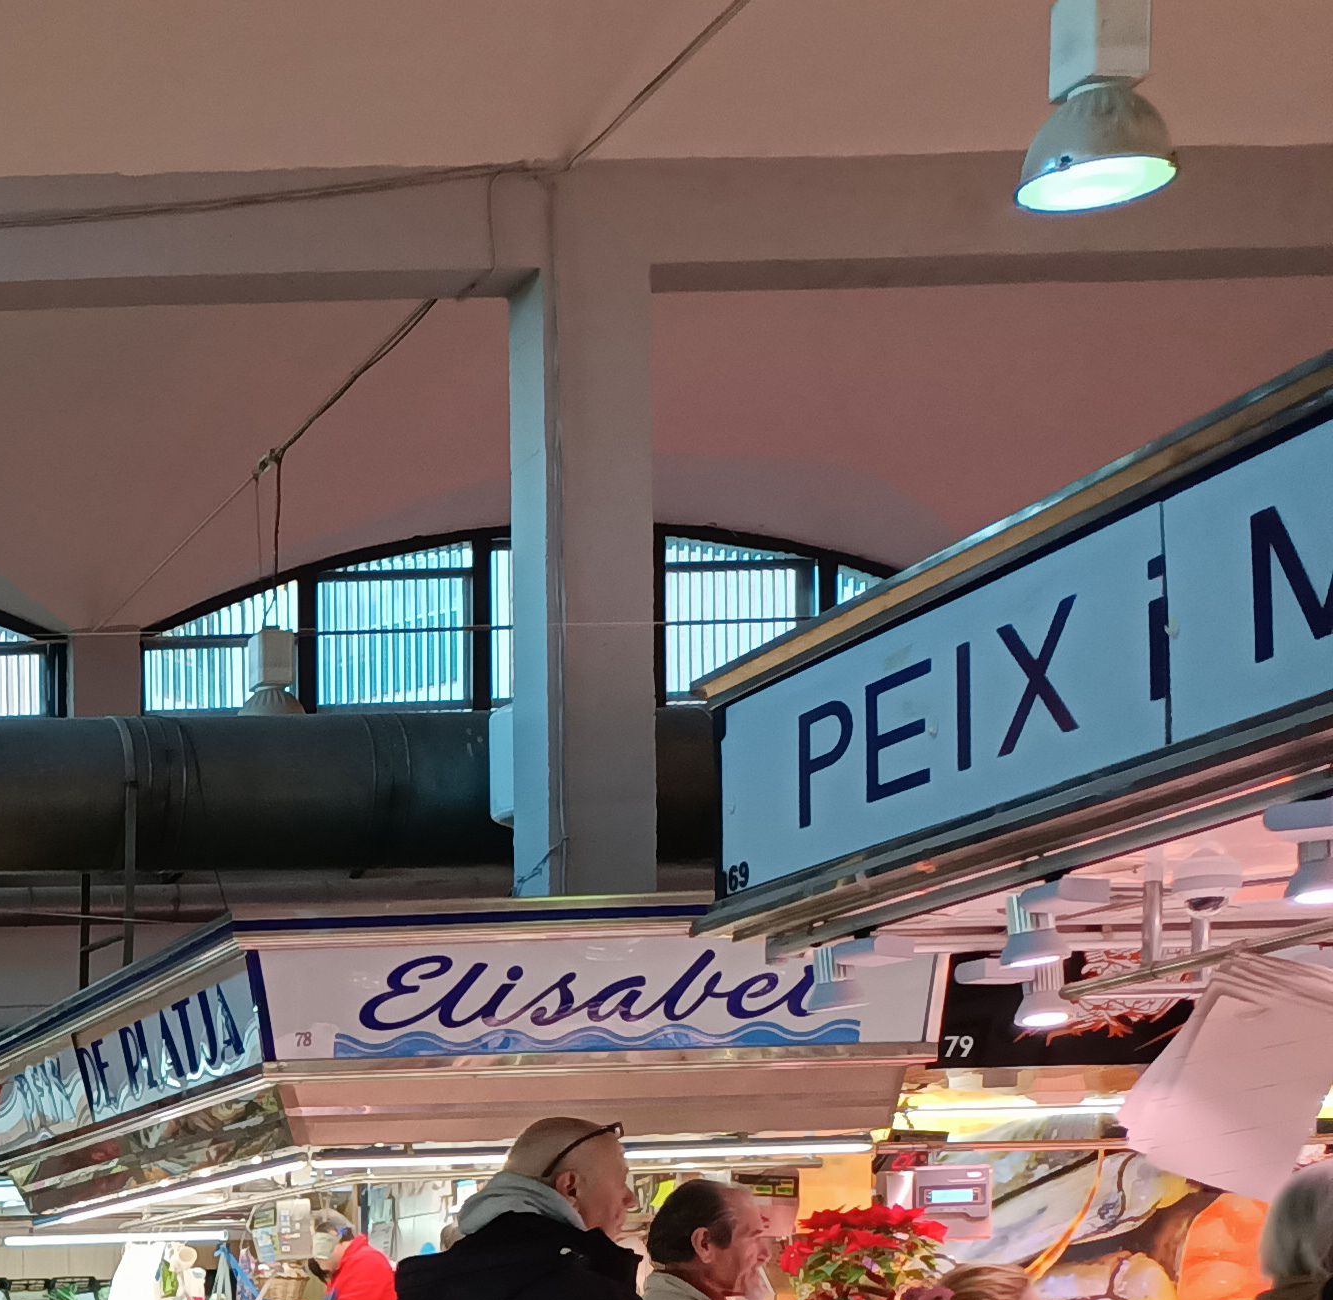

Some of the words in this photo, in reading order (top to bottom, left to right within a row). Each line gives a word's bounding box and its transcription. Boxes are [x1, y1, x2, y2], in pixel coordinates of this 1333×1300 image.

[798, 594, 1081, 829] PEIX
[727, 860, 751, 893] 69
[118, 983, 245, 1099] PLATJA
[294, 1031, 313, 1048] 78
[943, 1034, 974, 1059] 79
